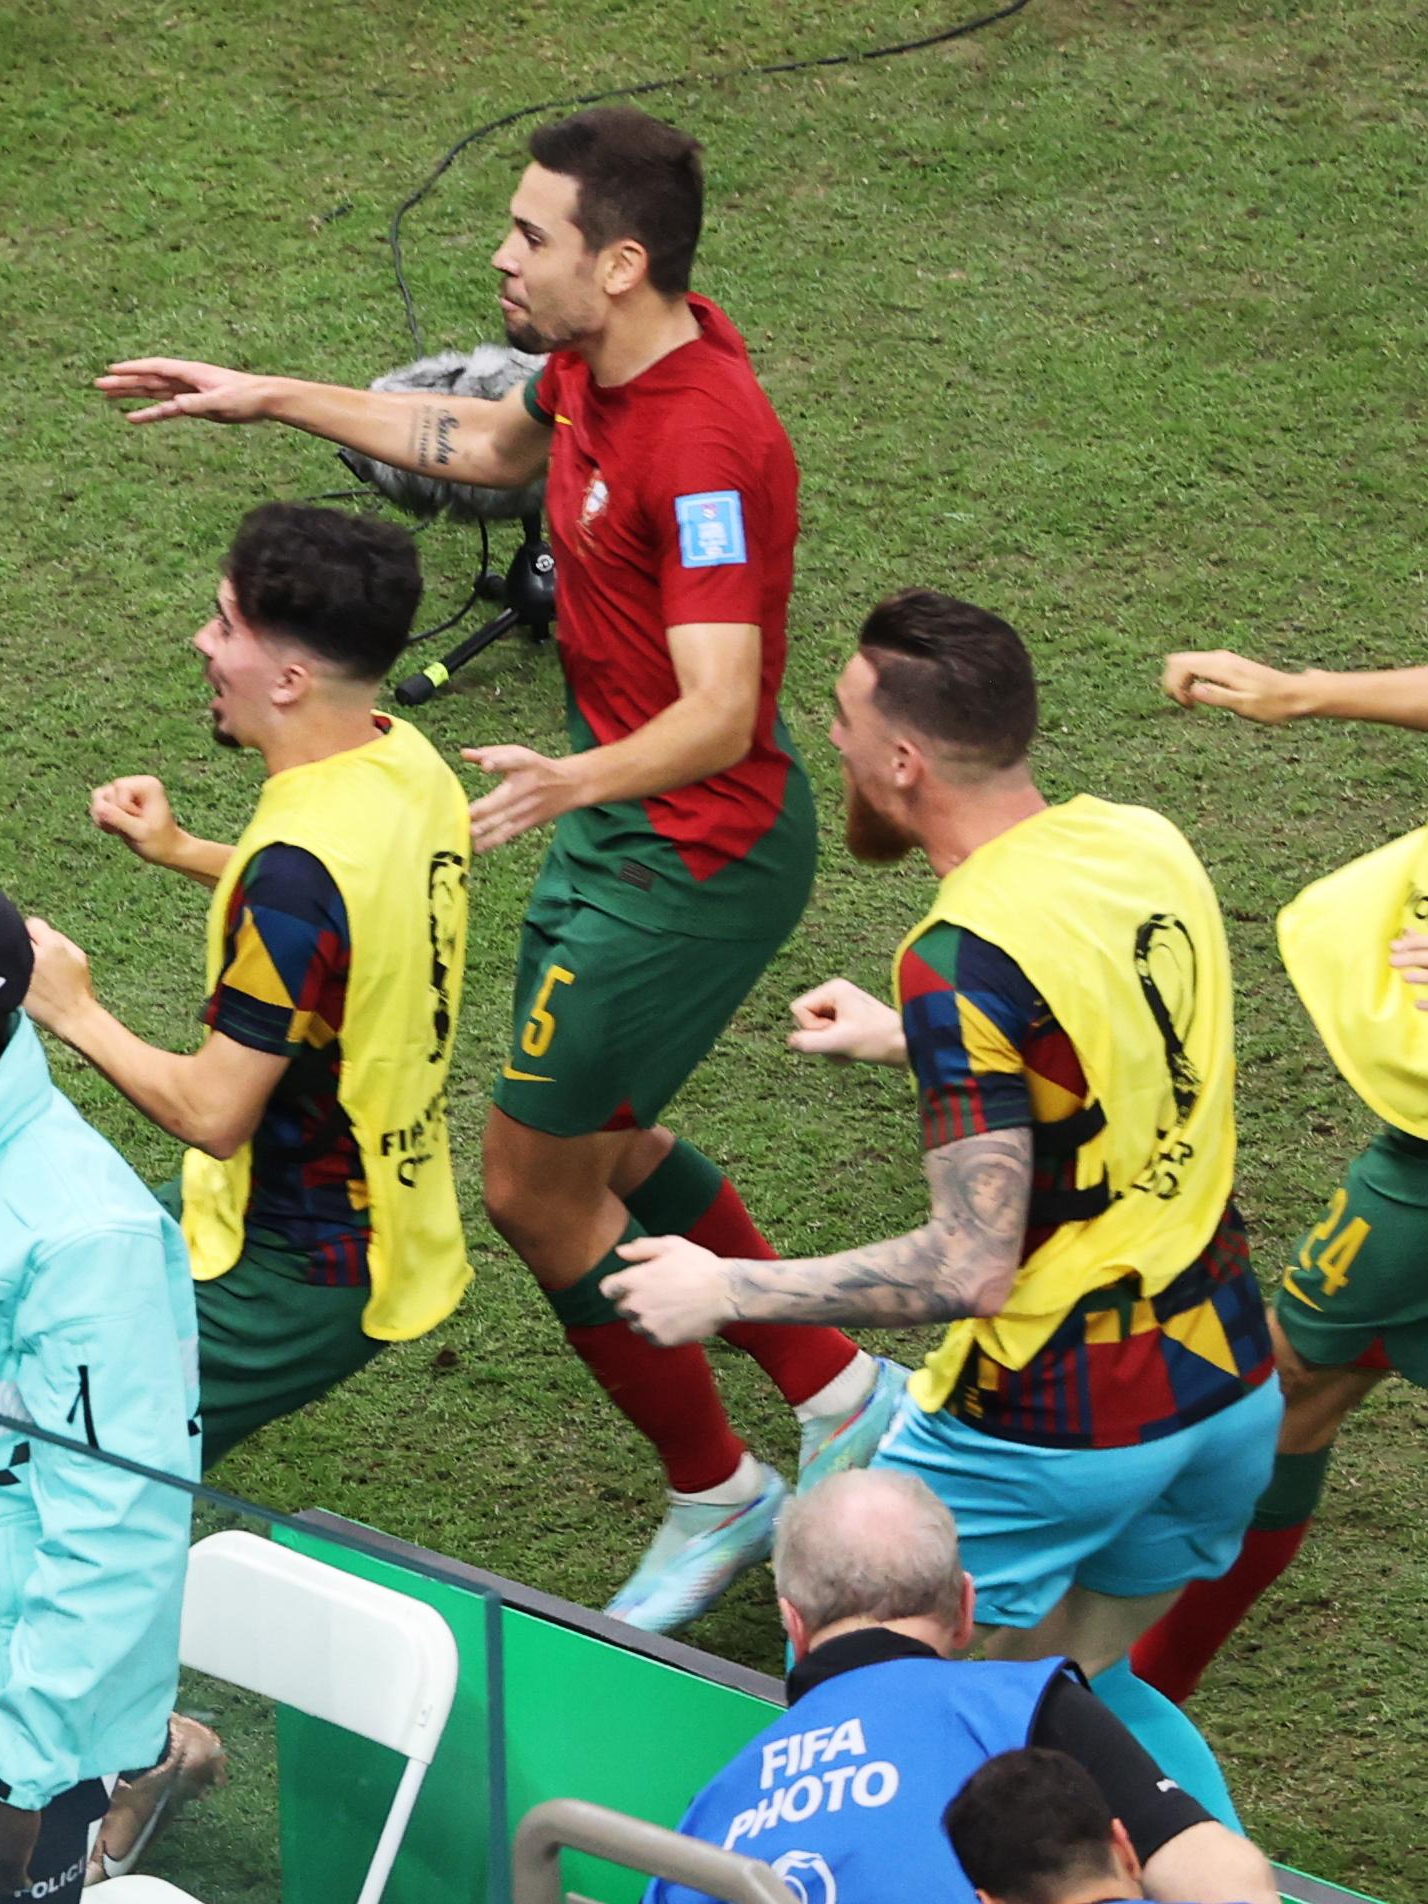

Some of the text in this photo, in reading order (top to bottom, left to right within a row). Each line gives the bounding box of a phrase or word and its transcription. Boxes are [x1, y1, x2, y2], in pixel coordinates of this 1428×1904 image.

[521, 964, 576, 1058] 5
[1299, 1187, 1371, 1297] 24
[760, 1718, 867, 1790] FIFA
[722, 1760, 900, 1851] PHOTO
